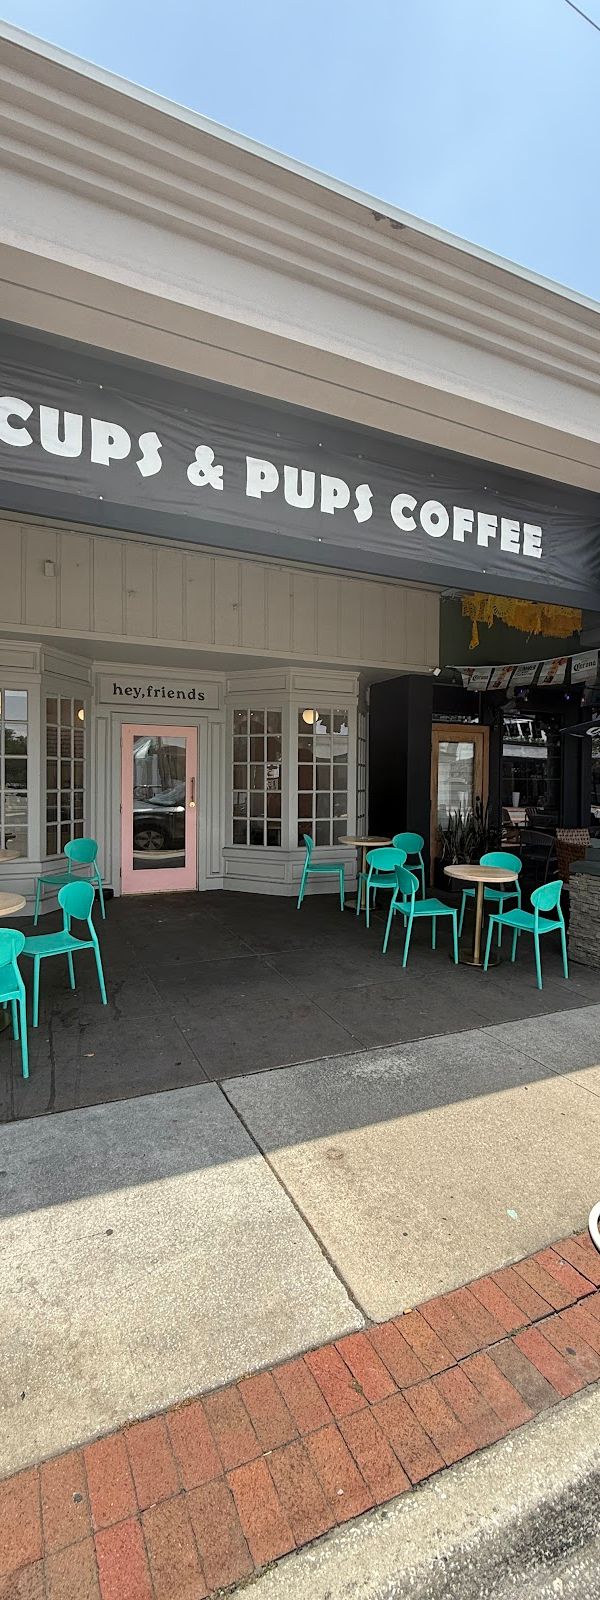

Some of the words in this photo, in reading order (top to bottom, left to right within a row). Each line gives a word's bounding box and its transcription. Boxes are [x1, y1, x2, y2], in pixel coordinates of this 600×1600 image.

[0, 396, 163, 478] CUPS
[186, 445, 224, 491] &
[245, 455, 374, 524] PUPS
[390, 493, 543, 559] COFFEE
